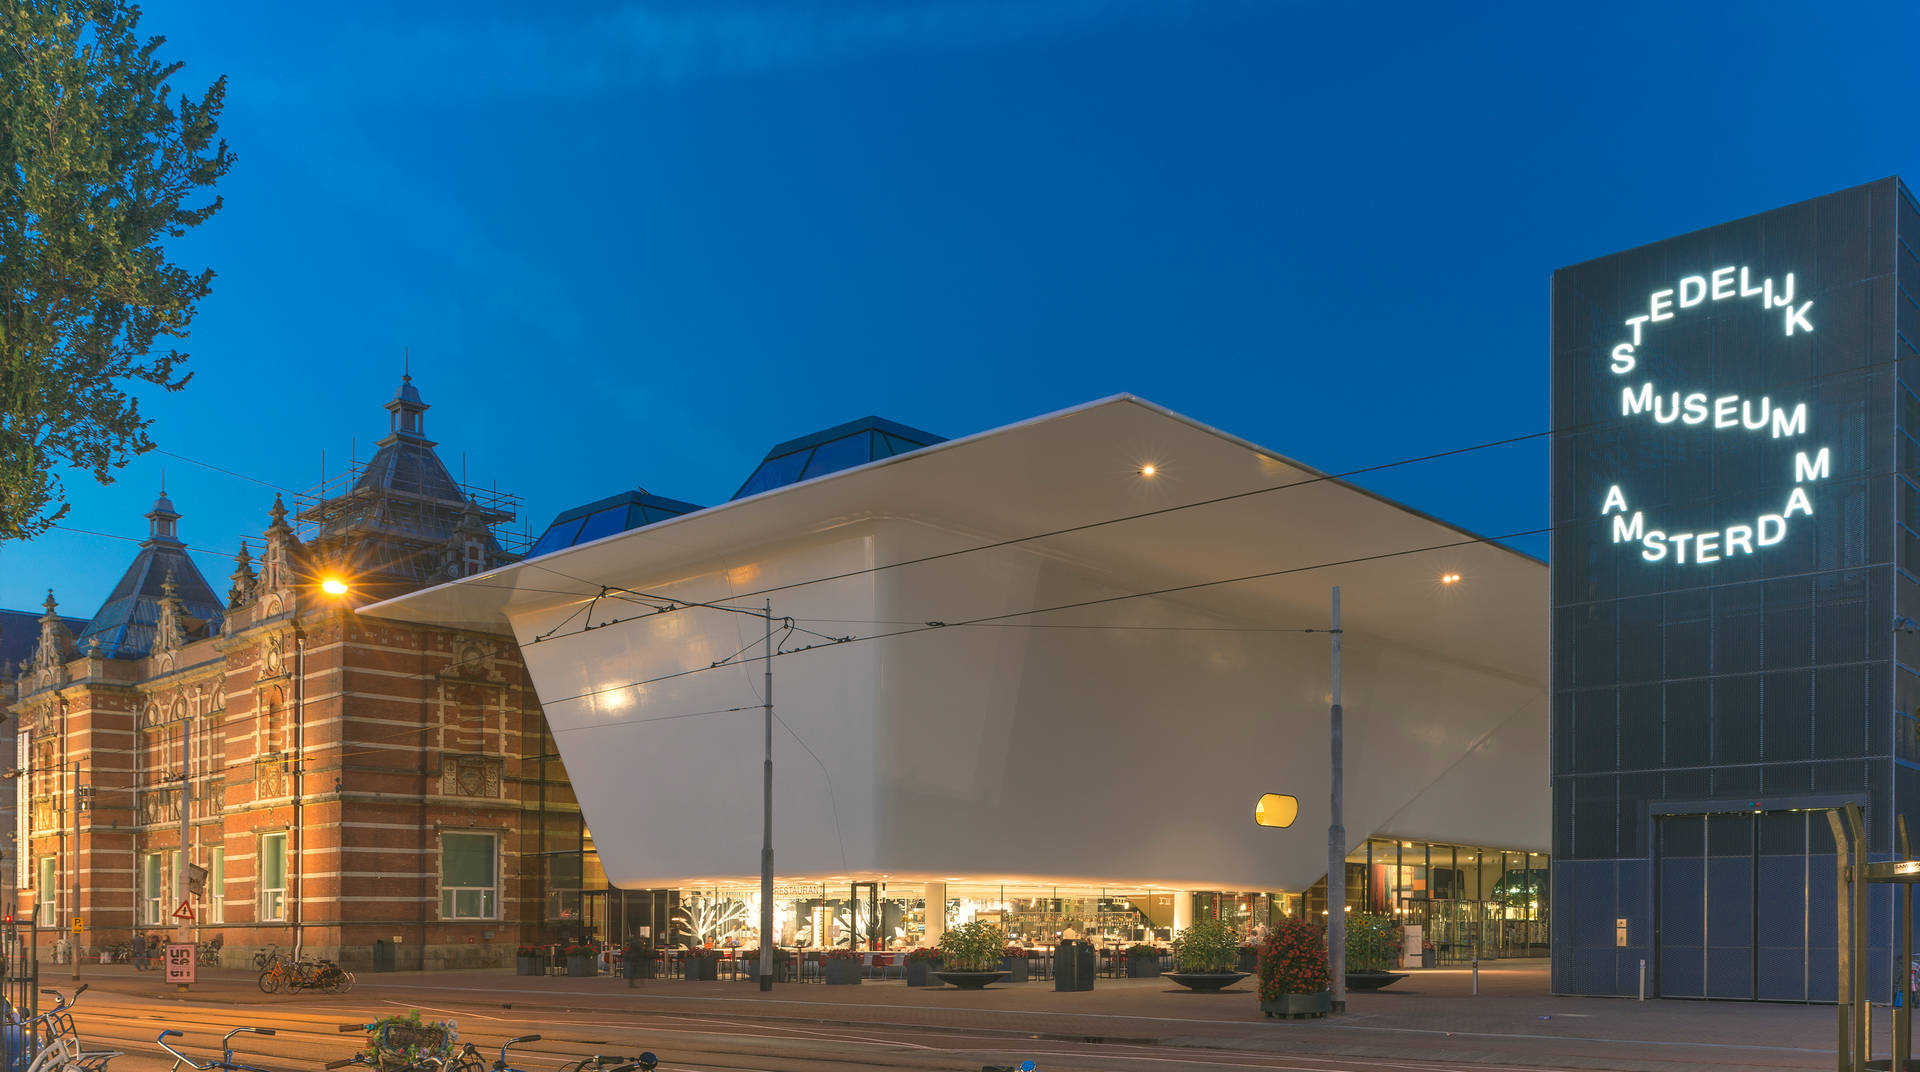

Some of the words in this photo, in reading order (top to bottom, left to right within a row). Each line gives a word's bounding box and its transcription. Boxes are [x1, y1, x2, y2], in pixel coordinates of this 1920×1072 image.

[1610, 265, 1814, 375] STEDELIJK
[1622, 382, 1807, 439] MUSEUM
[1601, 447, 1830, 564] AMSTERDAM
